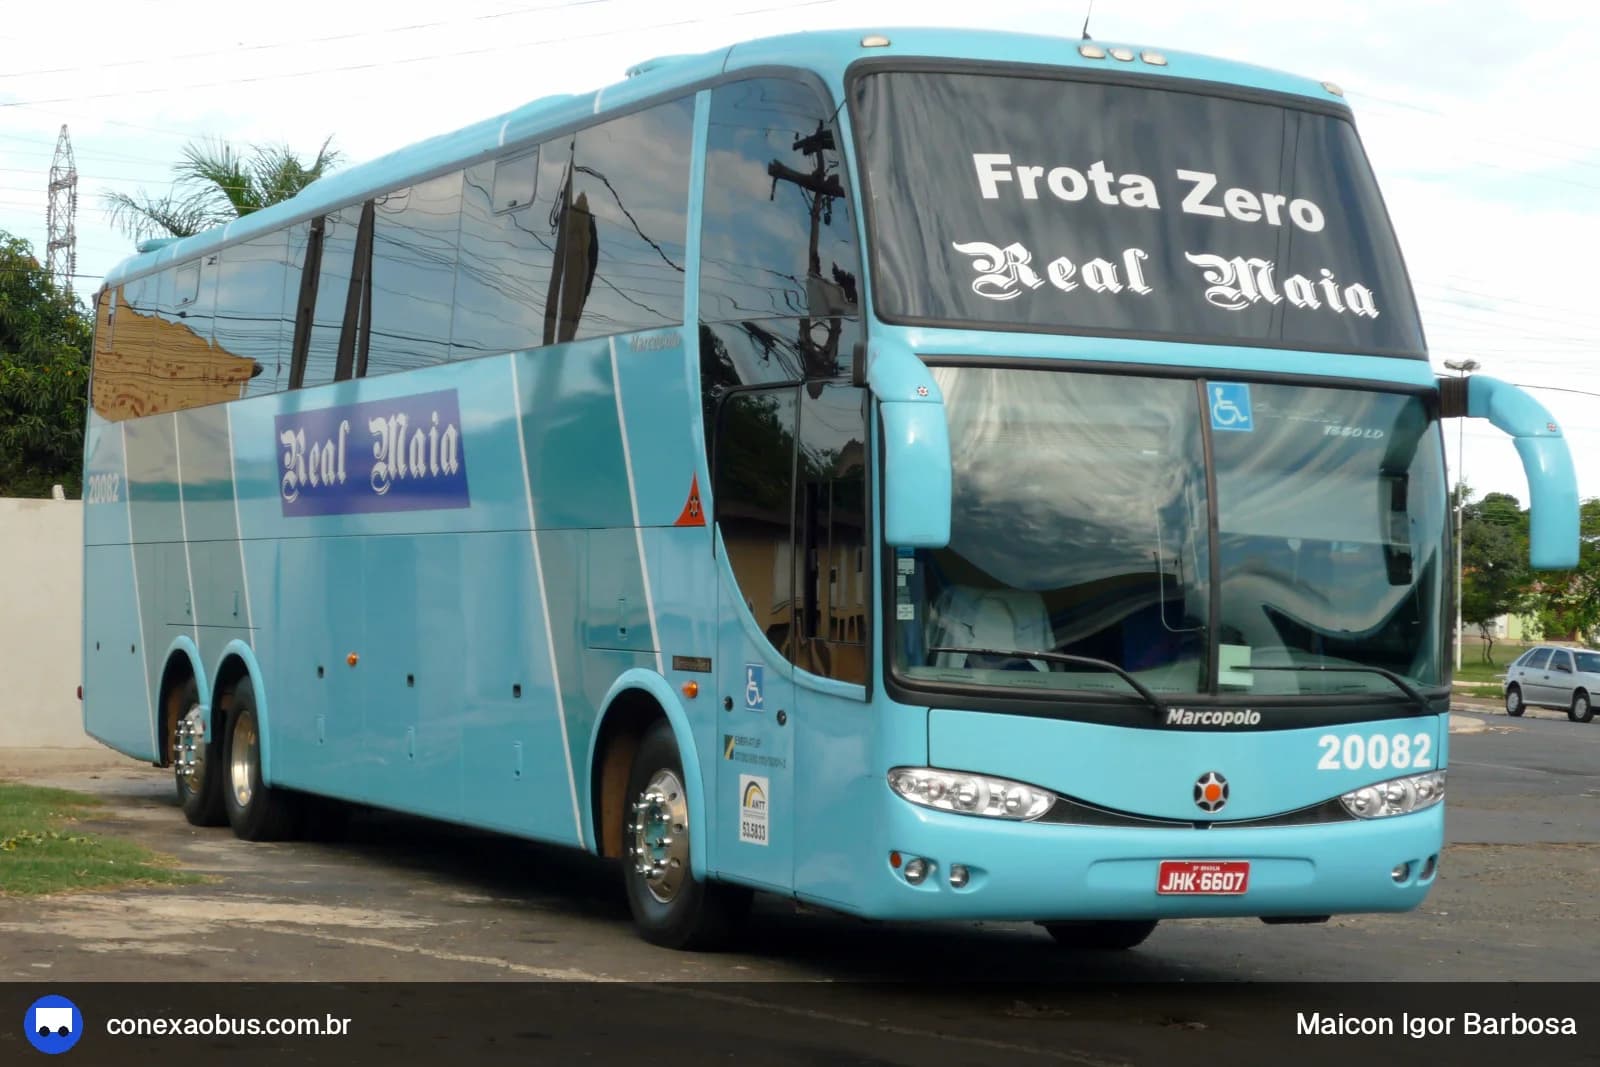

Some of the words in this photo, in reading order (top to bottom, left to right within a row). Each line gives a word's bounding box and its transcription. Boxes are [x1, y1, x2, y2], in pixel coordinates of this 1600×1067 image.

[973, 153, 1161, 211] Frota
[1177, 169, 1326, 233] Zero
[952, 240, 1154, 301] Real
[1185, 250, 1380, 320] Maia
[280, 418, 351, 503] Real
[368, 410, 459, 496] Maia
[1166, 707, 1261, 728] Marcopolo
[1317, 732, 1432, 770] 20082
